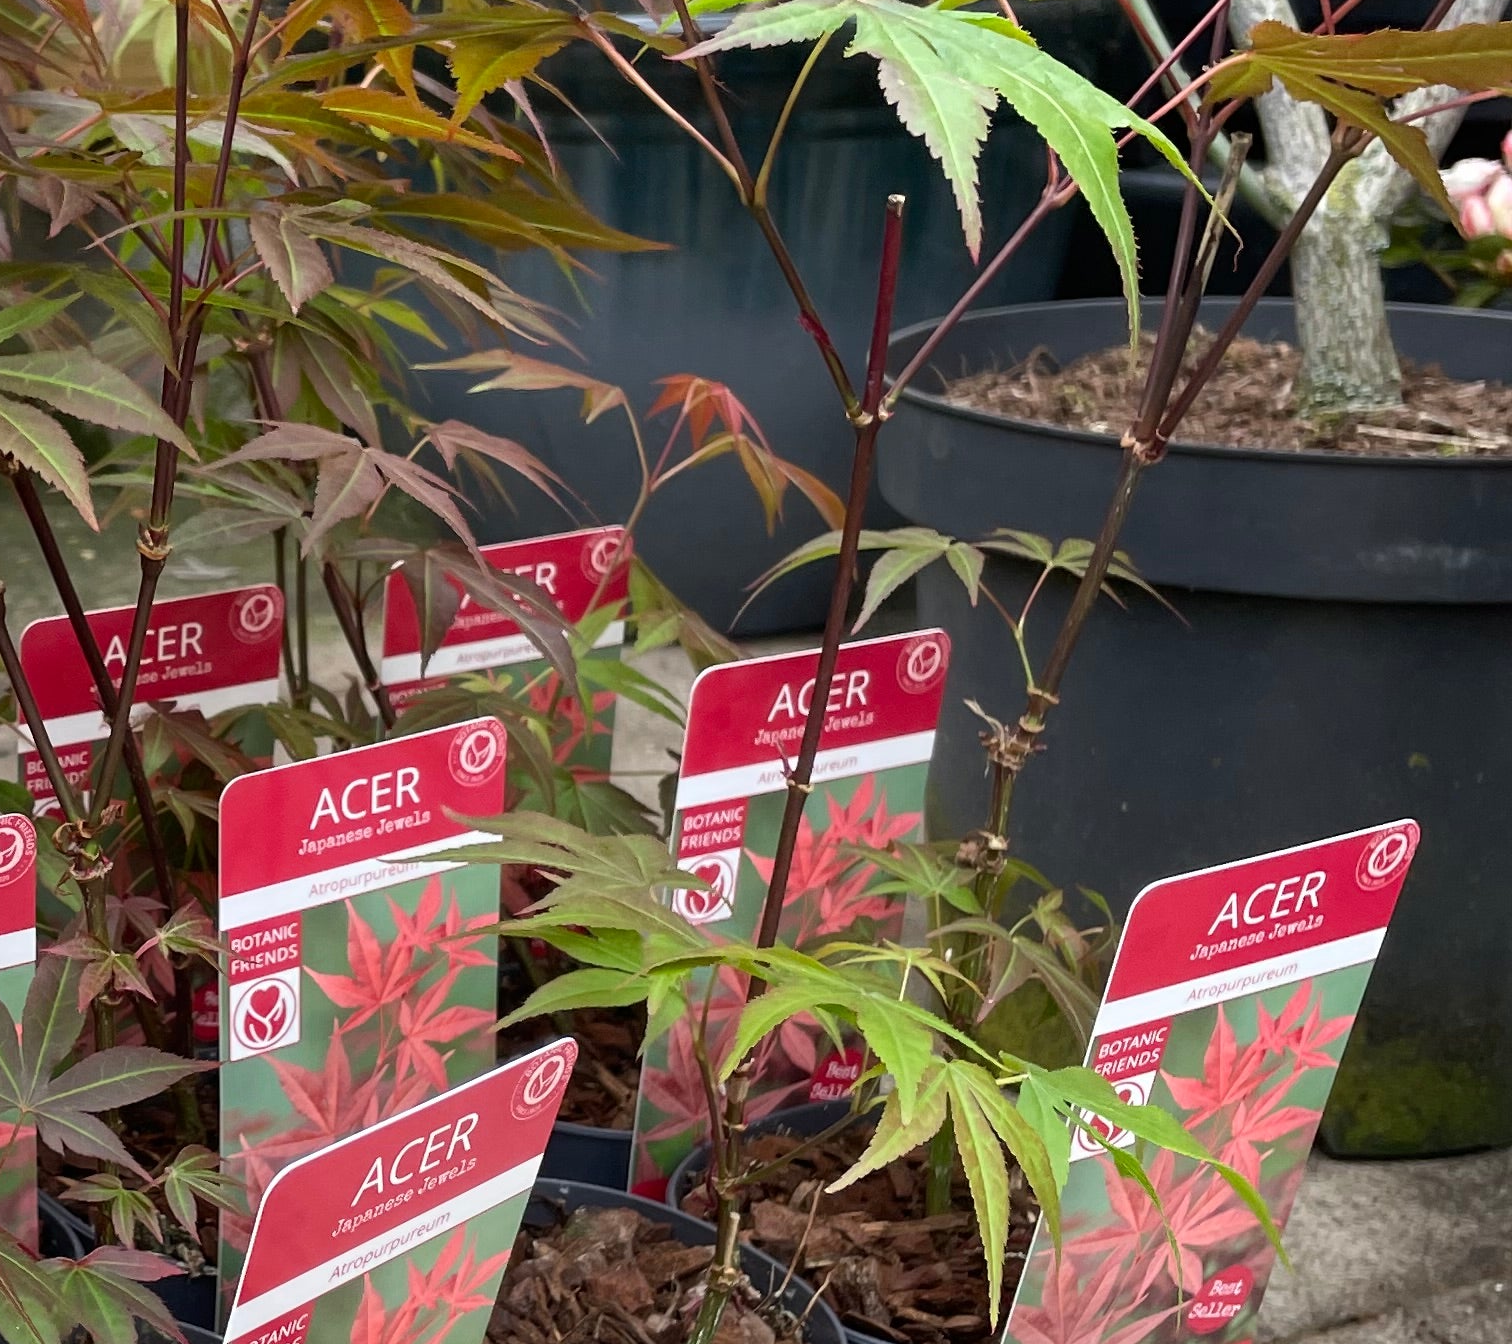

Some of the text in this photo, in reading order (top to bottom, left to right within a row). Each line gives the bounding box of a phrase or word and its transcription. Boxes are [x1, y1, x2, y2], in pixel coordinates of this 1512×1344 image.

[161, 661, 212, 681] Jewels
[824, 711, 874, 733] Jewels
[309, 766, 420, 830] ACER
[298, 809, 431, 856] Japanese Jewels
[682, 806, 745, 832] BOTANIC
[680, 827, 742, 851] FRIENDS
[1207, 870, 1327, 936] ACER
[231, 922, 299, 953] BOTANIC
[1189, 914, 1324, 961] Japanese Jewels
[231, 943, 299, 976] FRIENDS
[1186, 960, 1299, 1003] Atropurpureum
[1098, 1026, 1168, 1060] BOTANIC
[1094, 1047, 1161, 1077] FRIENDS
[350, 1112, 479, 1207] ACER
[331, 1156, 478, 1238] Japanese Jewels
[327, 1210, 451, 1283] Atropurpureum
[1208, 1279, 1244, 1297] Best
[1187, 1302, 1242, 1320] Seller
